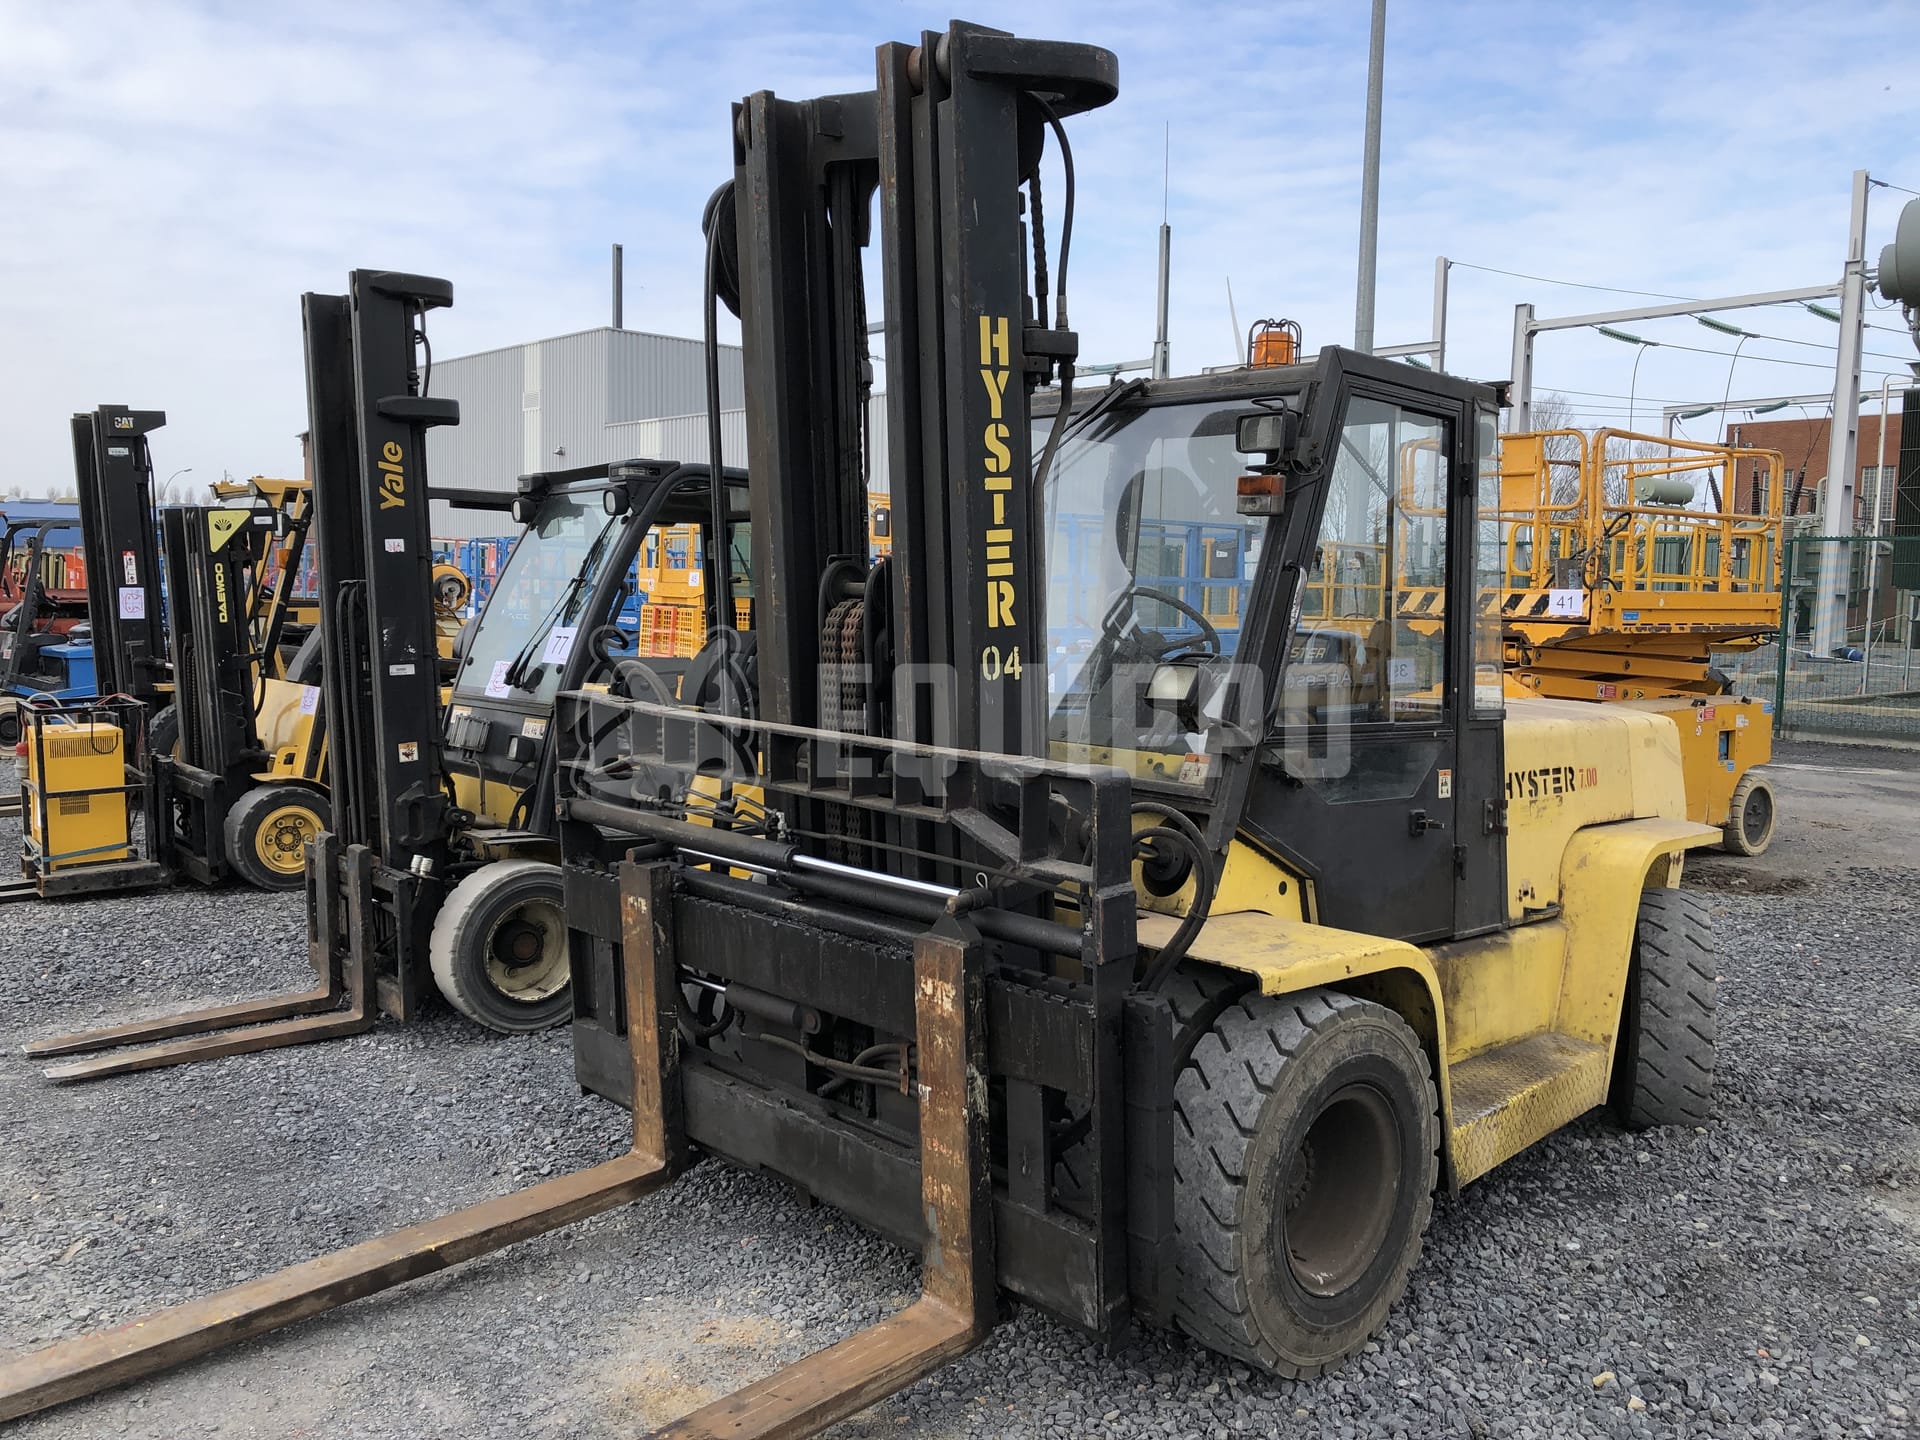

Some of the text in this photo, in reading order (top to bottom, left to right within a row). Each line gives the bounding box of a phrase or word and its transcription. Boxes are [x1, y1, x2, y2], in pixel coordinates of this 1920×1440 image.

[114, 416, 134, 429] CAT
[377, 441, 406, 510] Yale
[978, 315, 1017, 629] HYSTER
[214, 562, 228, 623] DAEWOO
[1556, 595, 1574, 609] 41
[551, 635, 570, 655] 77
[1289, 646, 1327, 659] STER
[982, 645, 1023, 681] 04
[1578, 767, 1598, 789] 7.00
